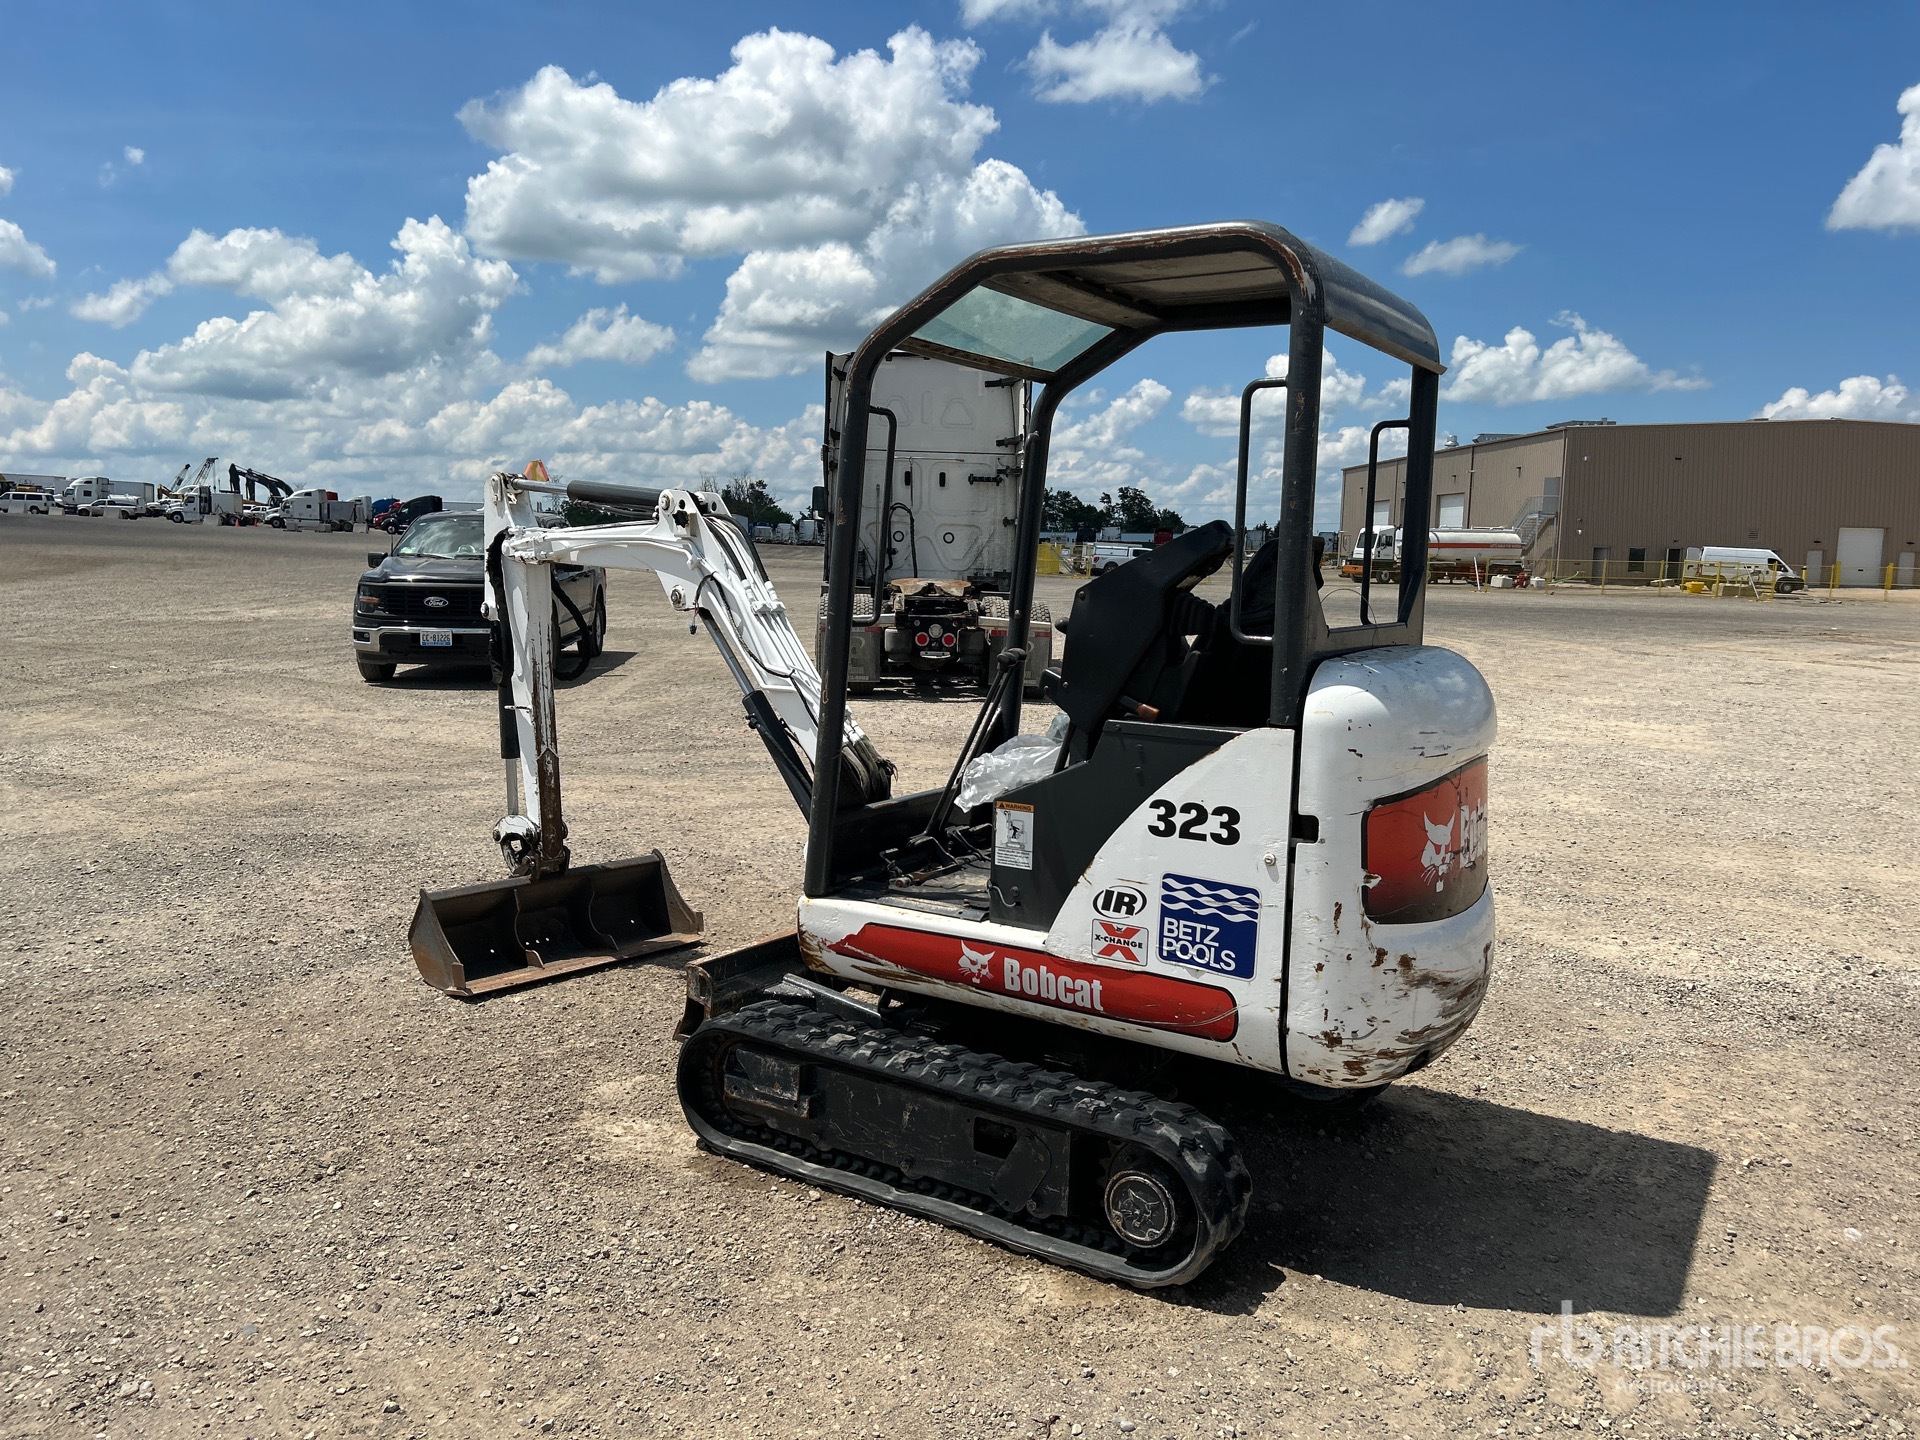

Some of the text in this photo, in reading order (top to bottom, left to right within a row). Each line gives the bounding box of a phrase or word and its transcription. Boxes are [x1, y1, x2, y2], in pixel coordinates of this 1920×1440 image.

[1005, 803, 1032, 811] WARNING
[1148, 799, 1240, 845] 323
[1101, 889, 1138, 916] IR
[1094, 933, 1143, 949] X-CHANGE
[1163, 917, 1220, 946] BETZ
[1162, 938, 1236, 971] POOLS
[1003, 957, 1103, 1011] Bobcat
